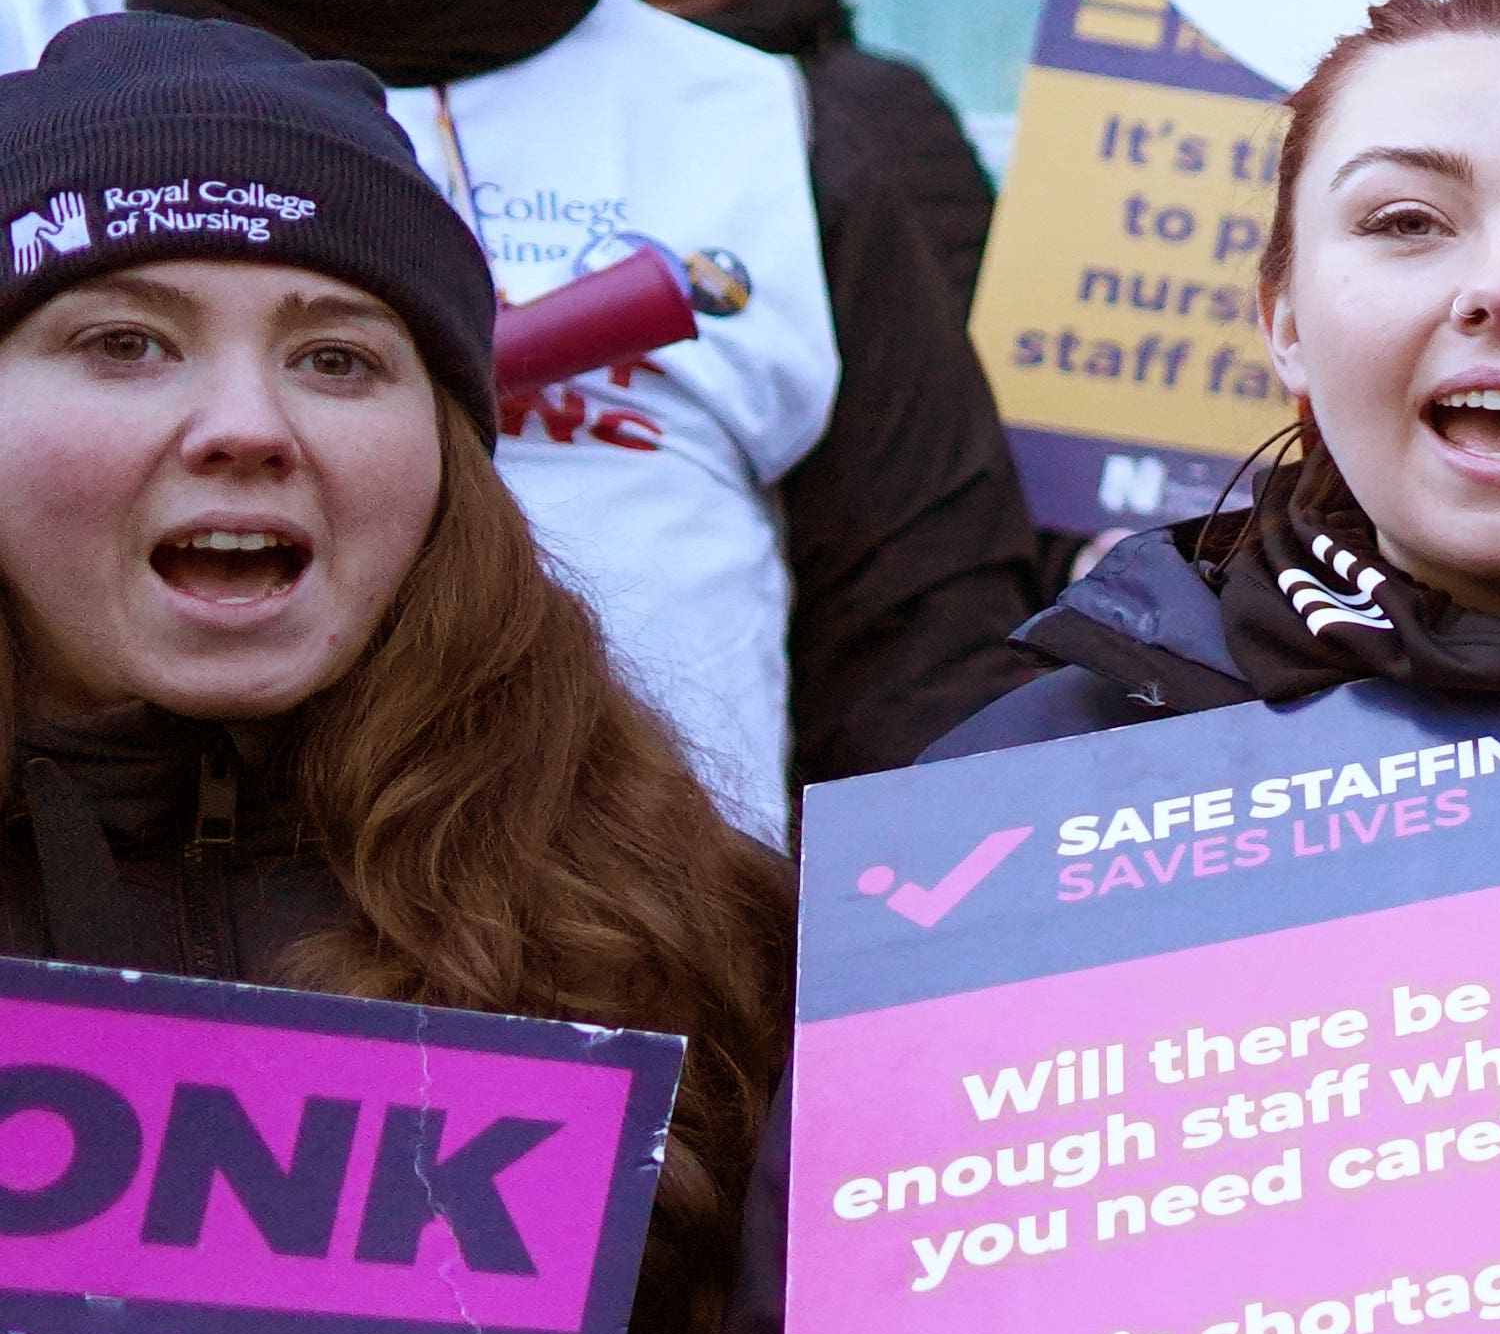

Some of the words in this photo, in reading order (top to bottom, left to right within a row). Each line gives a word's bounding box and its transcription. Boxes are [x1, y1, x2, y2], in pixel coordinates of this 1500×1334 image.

[104, 179, 190, 212] Royal
[199, 181, 316, 220] College
[107, 211, 139, 239] of
[145, 208, 270, 241] Nursing
[1124, 192, 1195, 242] to
[1013, 324, 1192, 388] staff
[1056, 789, 1235, 857] SAFE
[1057, 828, 1269, 903] SAVES
[1291, 786, 1472, 857] LIVES
[961, 1051, 1125, 1123] Will
[1148, 1000, 1369, 1088] there
[1393, 979, 1491, 1039] be
[831, 1108, 1155, 1220] enough
[1181, 1065, 1369, 1151] staff
[909, 1207, 1069, 1293] you
[1094, 1157, 1303, 1245] need
